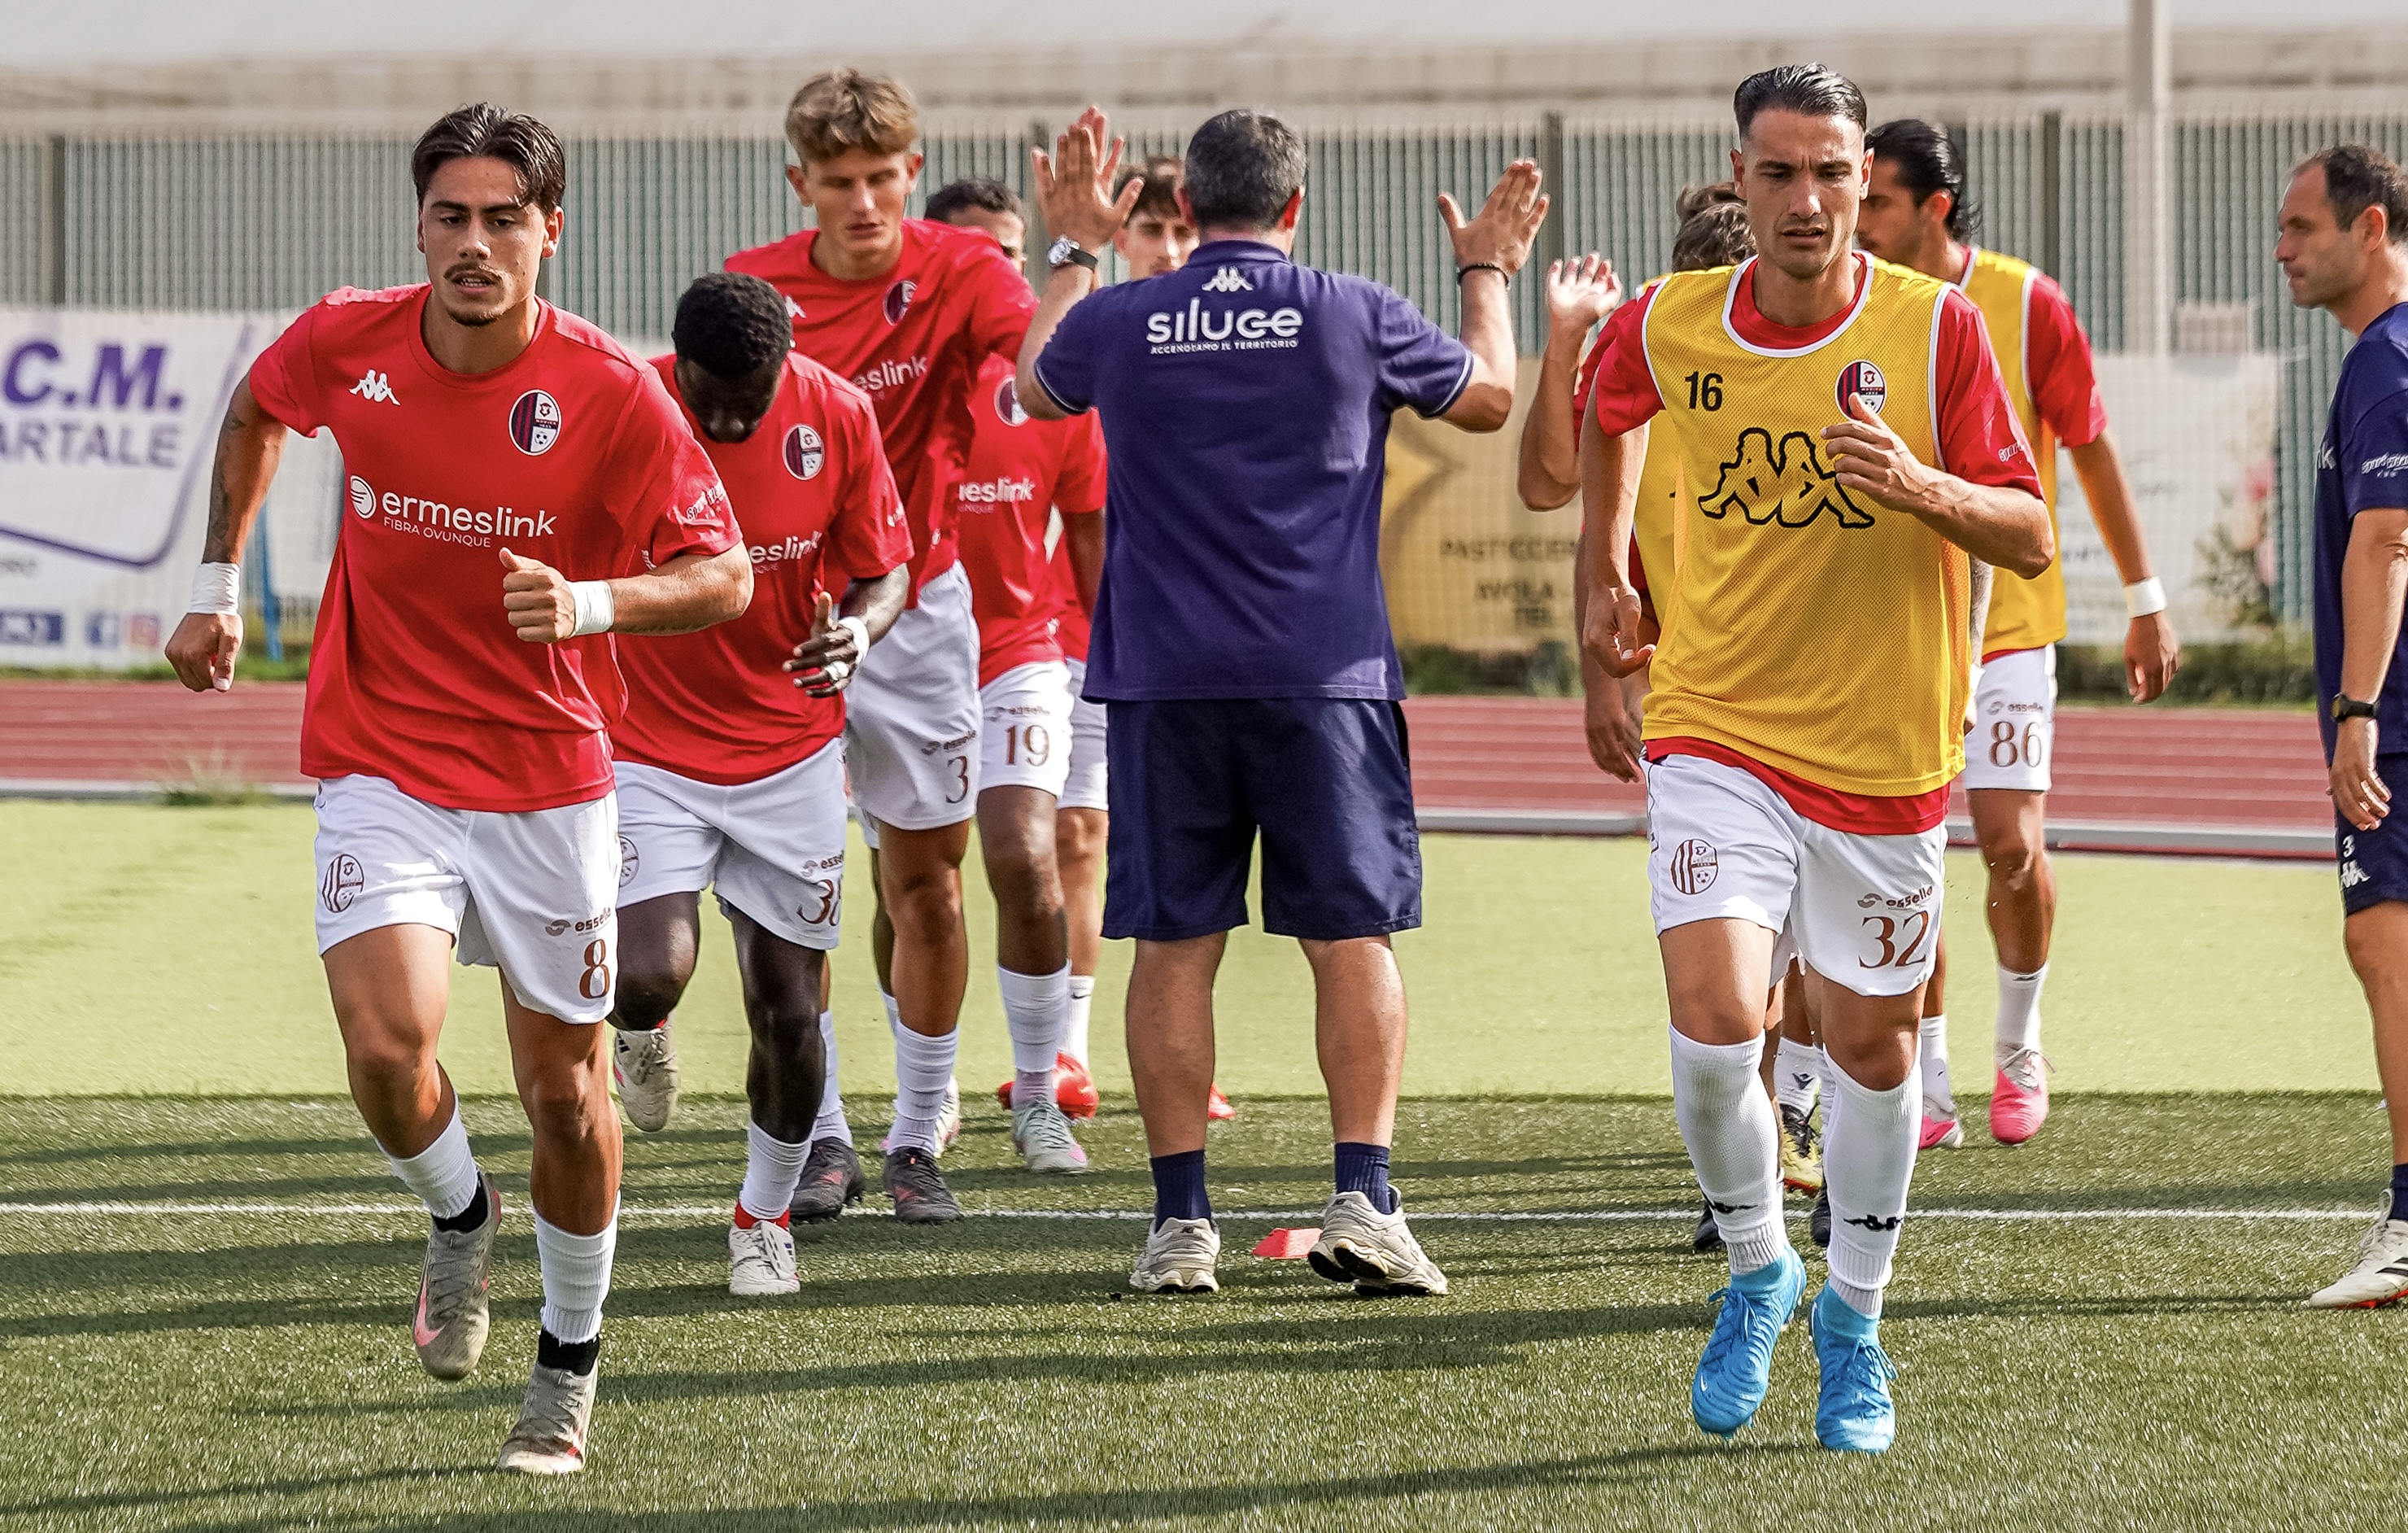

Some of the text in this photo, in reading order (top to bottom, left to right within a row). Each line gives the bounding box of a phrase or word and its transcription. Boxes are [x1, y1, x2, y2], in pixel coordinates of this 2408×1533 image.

[1221, 342, 1232, 351] IL
[1234, 338, 1299, 351] TERRITORIO
[1684, 370, 1723, 412] 16
[0, 421, 180, 466] RTALE
[382, 491, 557, 538] ermeslink
[384, 517, 491, 548] FIBRA OVUNQUE
[1006, 724, 1050, 767] 19
[1989, 721, 2042, 768] 86
[945, 755, 969, 804] 3
[2343, 834, 2356, 858] 3
[1858, 911, 1929, 969] 32
[579, 938, 610, 999] 8
